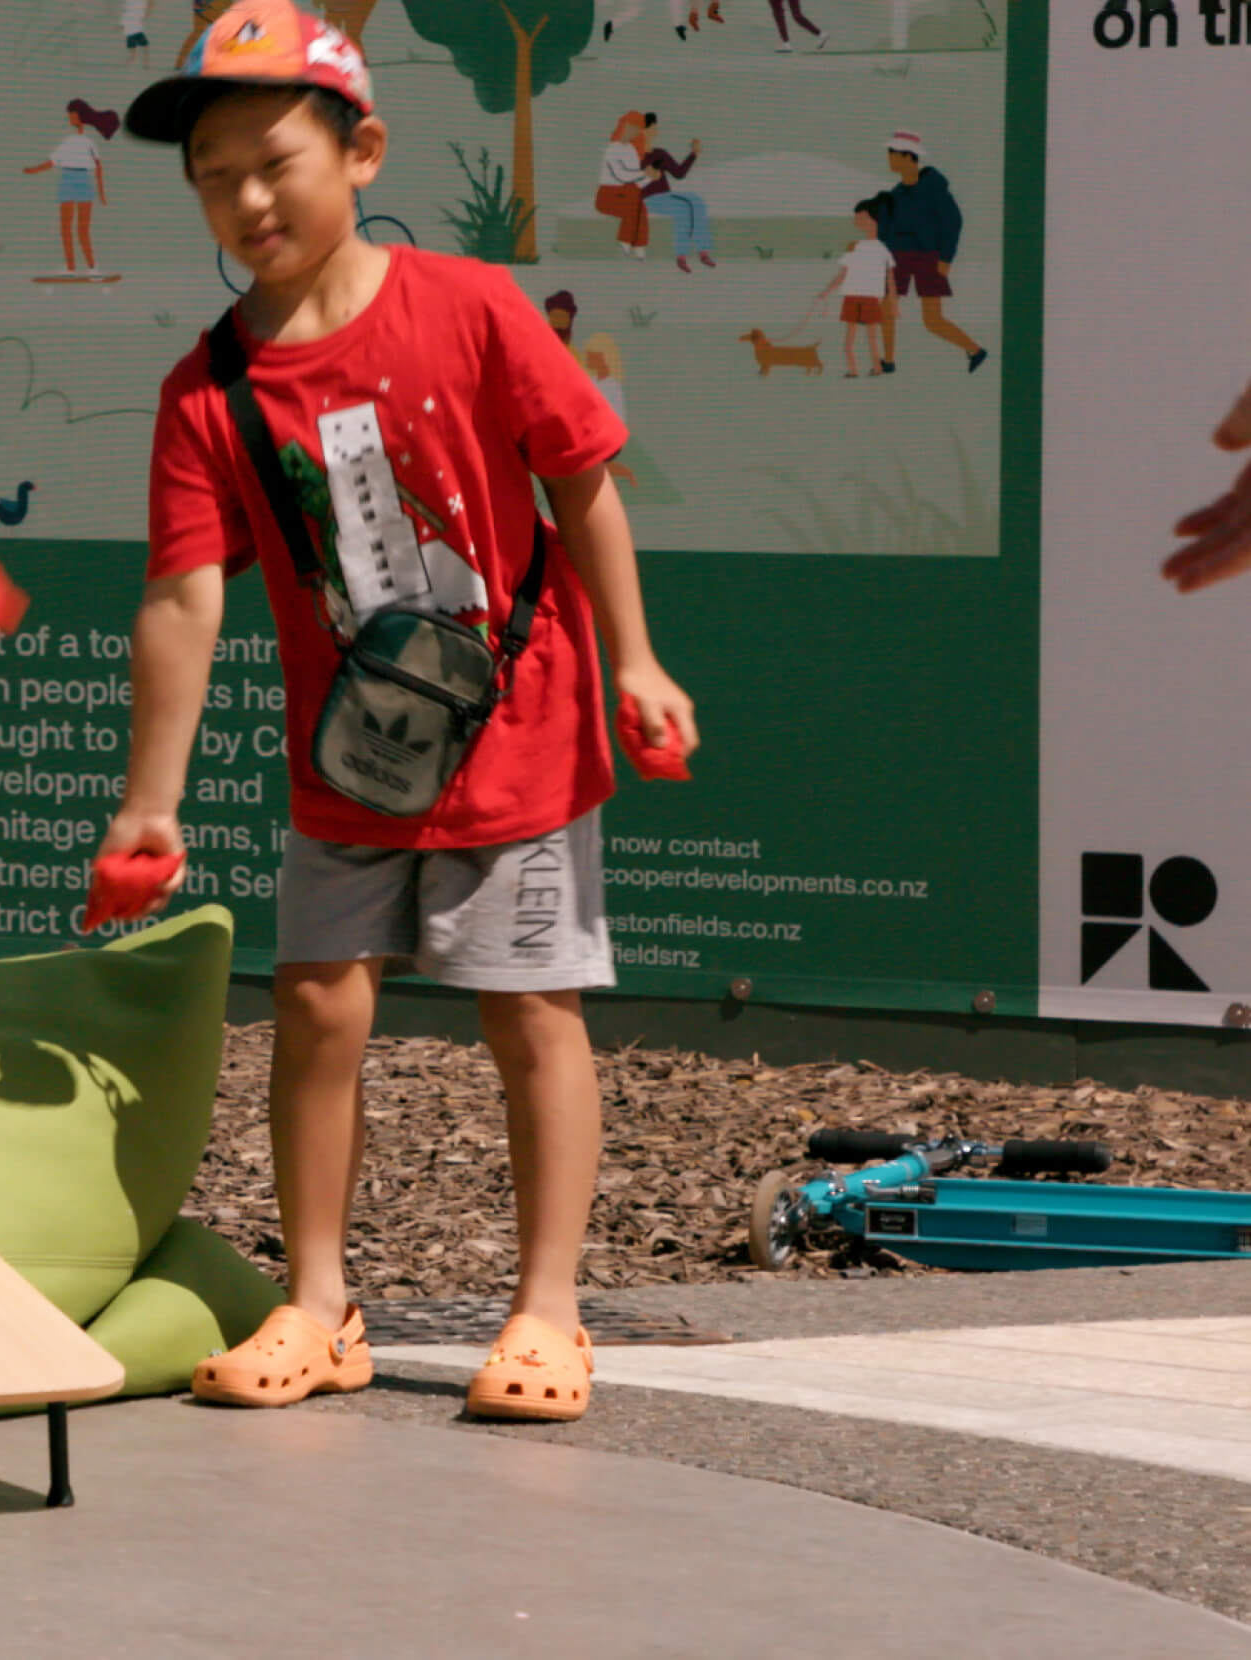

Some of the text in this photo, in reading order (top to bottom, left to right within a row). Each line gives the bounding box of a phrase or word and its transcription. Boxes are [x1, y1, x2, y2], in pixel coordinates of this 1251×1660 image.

[15, 625, 50, 657] of
[59, 633, 80, 658] a
[20, 673, 134, 714] people
[82, 721, 118, 752] to
[200, 722, 243, 765] by
[196, 772, 263, 804] and
[611, 836, 662, 854] now
[668, 836, 761, 859] contact
[510, 837, 563, 949] KLEIN
[602, 866, 928, 898] cooperdevelopments.co.nz
[606, 914, 802, 941] estonfields.co.nz
